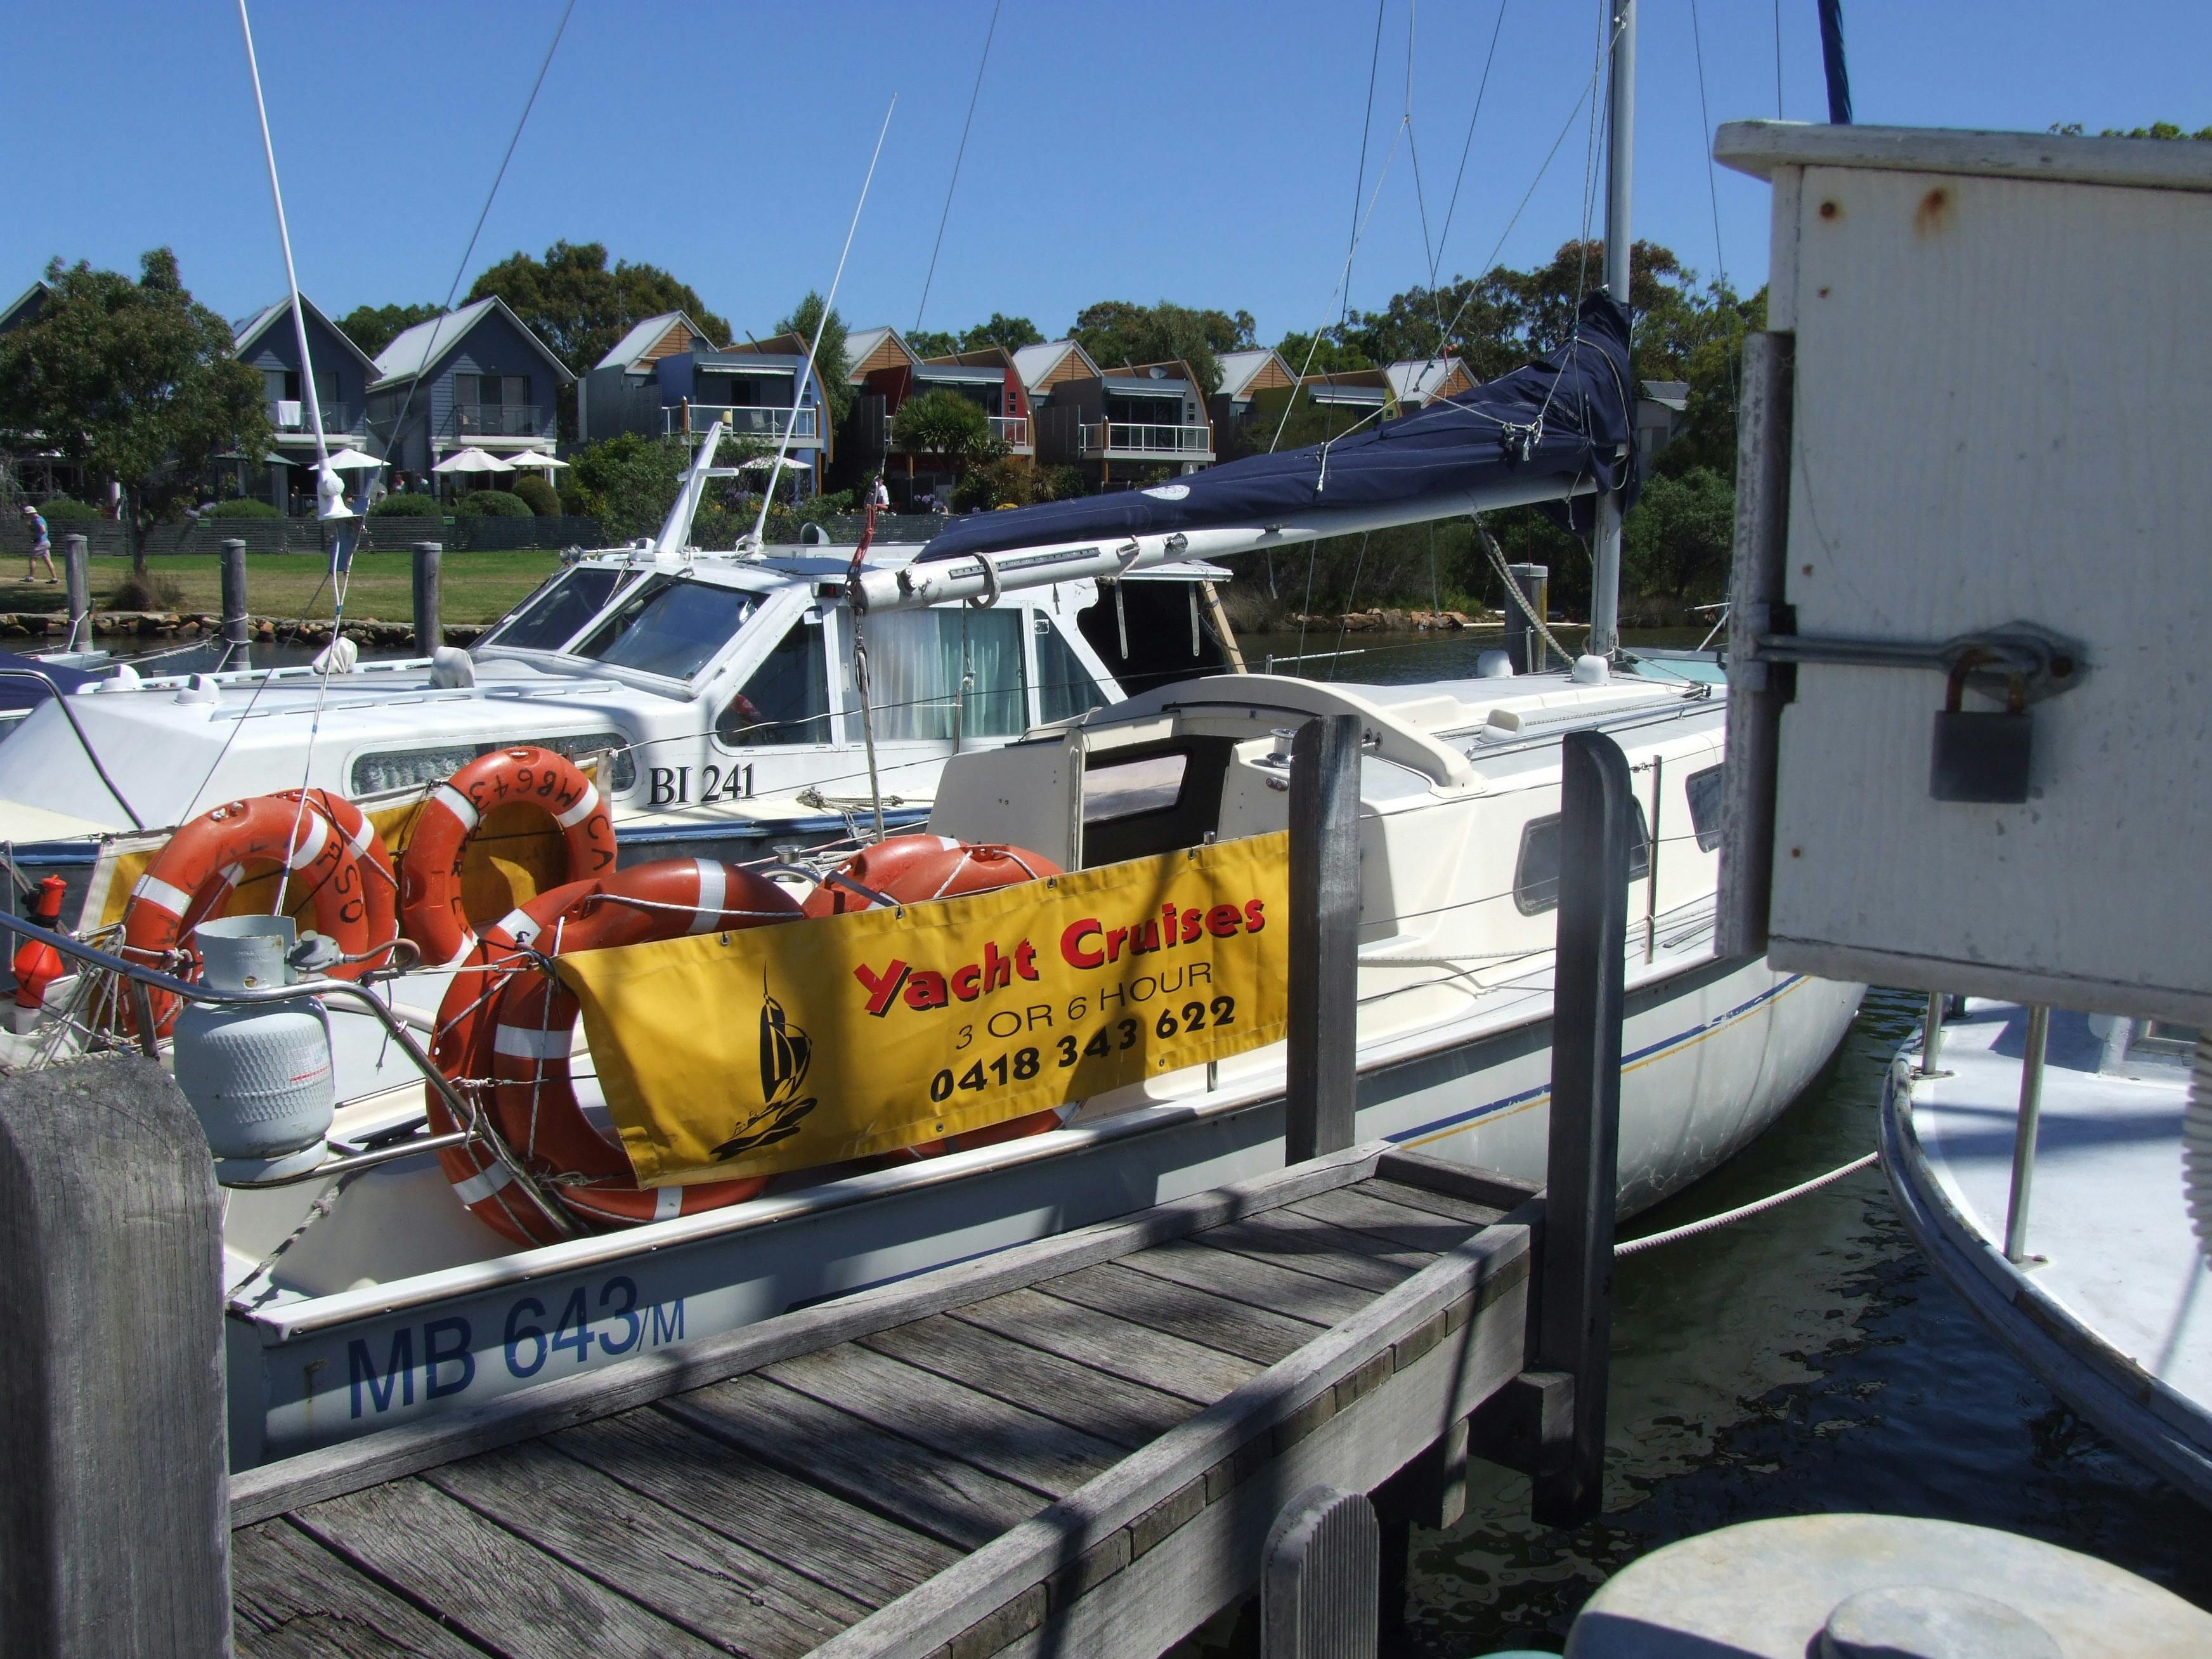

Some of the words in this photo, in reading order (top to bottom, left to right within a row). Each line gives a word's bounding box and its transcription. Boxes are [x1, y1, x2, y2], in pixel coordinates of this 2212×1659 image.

[647, 765, 693, 807] BI
[701, 762, 758, 805] 241
[853, 937, 1039, 1018] Yacht
[1060, 899, 1265, 970] Cruises
[955, 1024, 973, 1050] 3
[987, 1004, 1053, 1038] OR
[1067, 996, 1087, 1020] 6
[1100, 962, 1212, 1012] HOUR
[930, 1046, 1041, 1103] 0418
[1056, 1018, 1138, 1068] 343
[1155, 995, 1235, 1039] 622
[348, 1315, 476, 1420] MB
